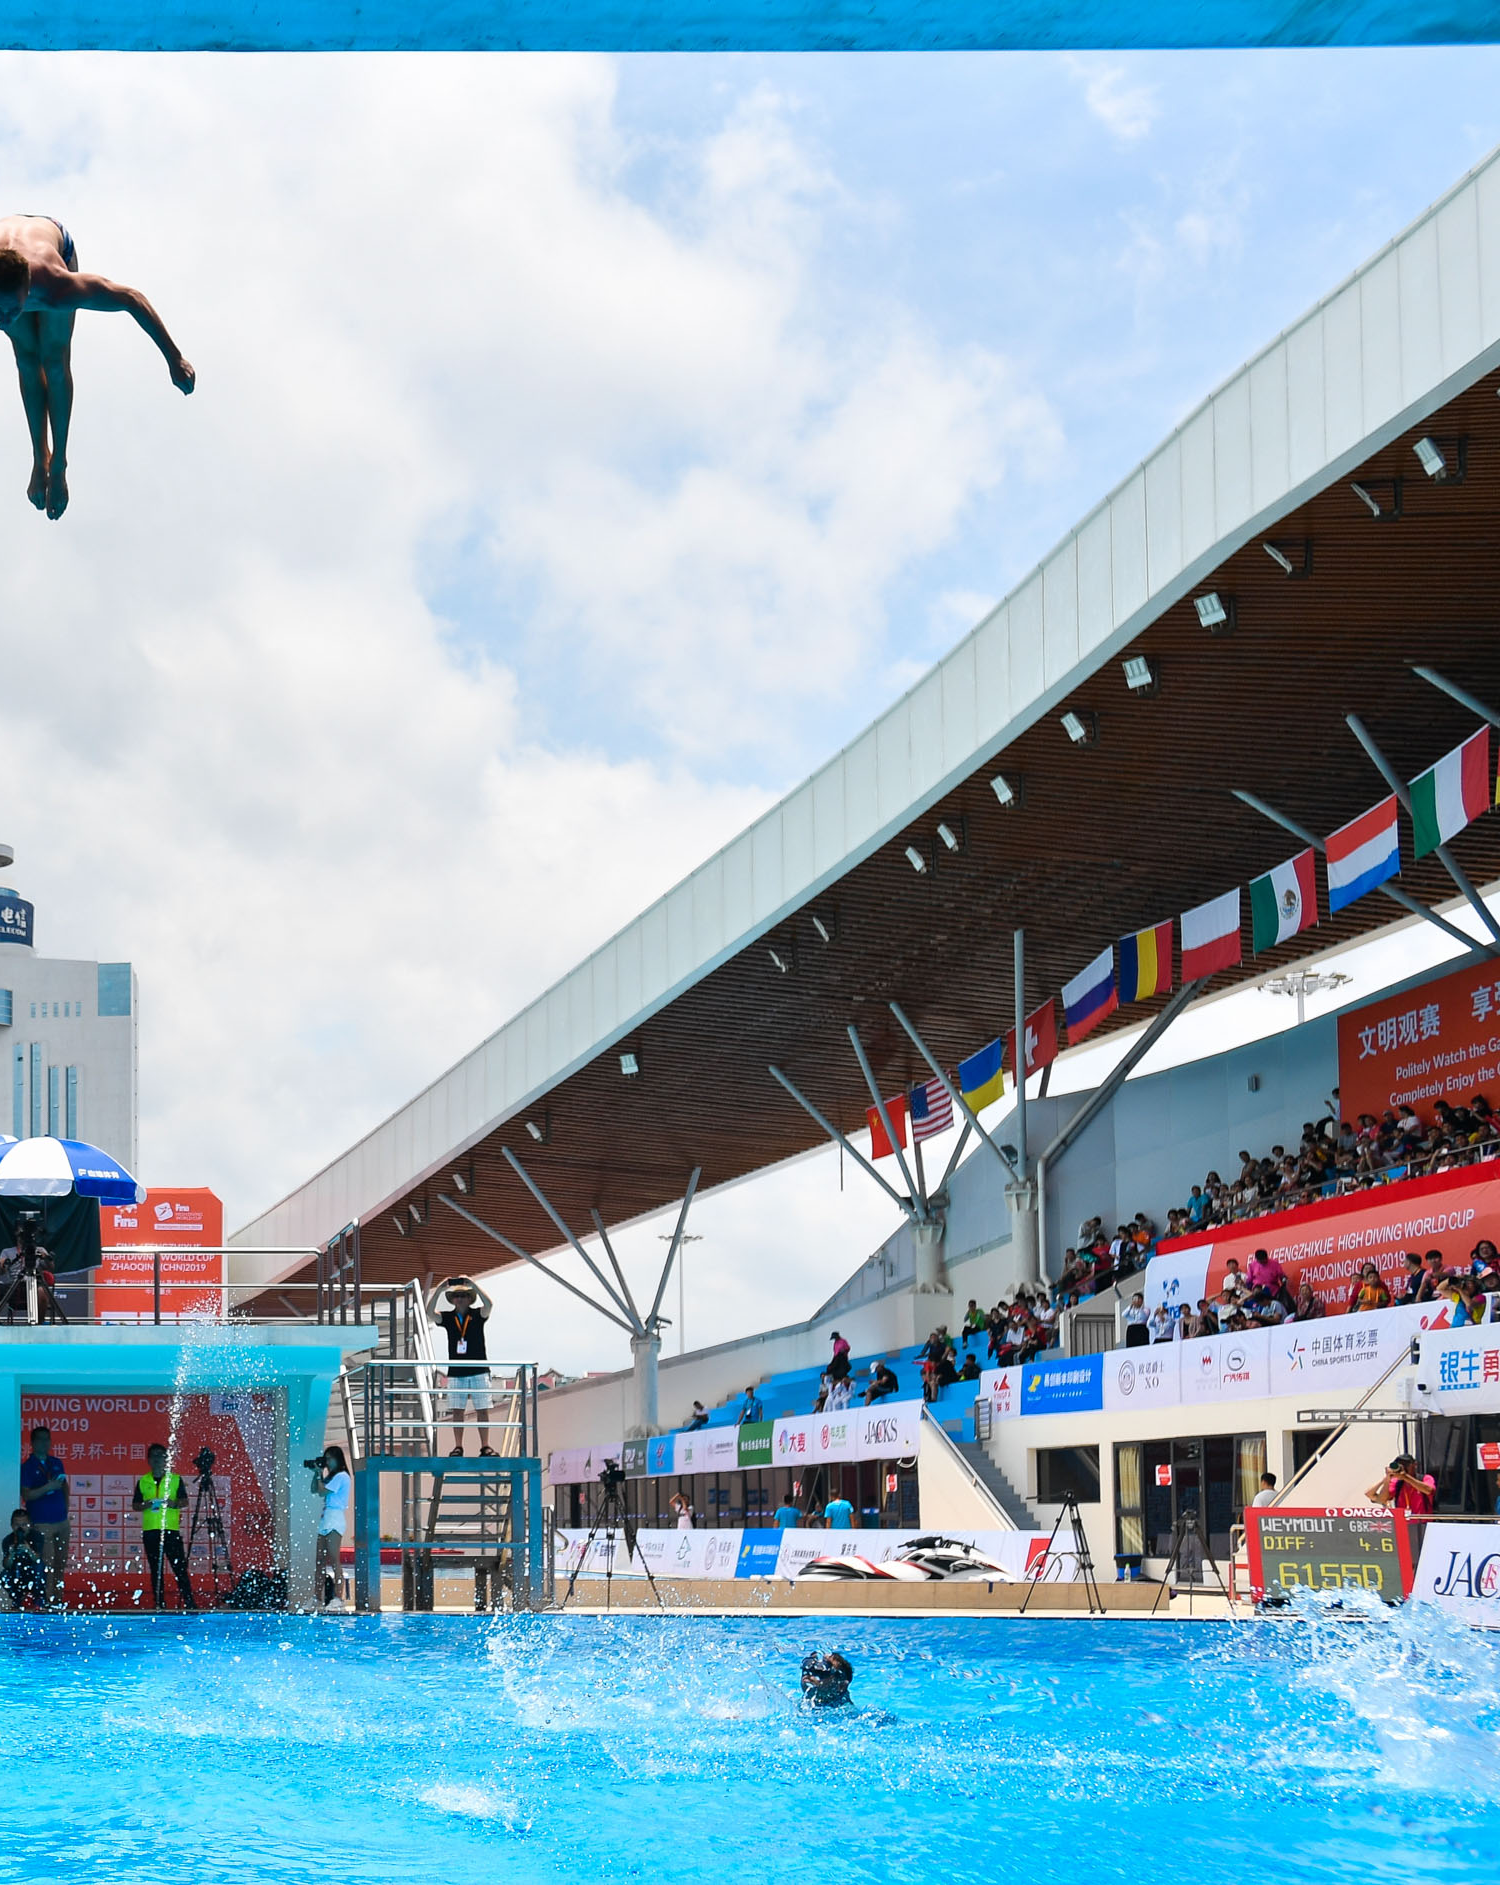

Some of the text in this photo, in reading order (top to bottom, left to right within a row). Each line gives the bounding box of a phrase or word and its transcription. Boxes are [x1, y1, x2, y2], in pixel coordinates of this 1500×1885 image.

[1358, 1004, 1440, 1060] 文明观赛
[1396, 1058, 1431, 1081] Politely
[1433, 1048, 1466, 1069] Watch
[1469, 1043, 1486, 1058] the
[1389, 1067, 1495, 1107] Completely Enjoy the
[1273, 1237, 1334, 1264] FENGZHIXUE
[1337, 1232, 1363, 1252] HIGH
[1365, 1225, 1402, 1247] DIVING
[1404, 1213, 1447, 1238] WORLD
[1448, 1208, 1474, 1230] CUP
[1311, 1328, 1378, 1356] 中国体育彩票
[1330, 1354, 1351, 1365] SPORTS
[1352, 1351, 1378, 1361] LOTTERY
[1440, 1350, 1480, 1383] 银牛
[22, 1398, 81, 1413] DIVING
[85, 1398, 150, 1413] WORLD
[789, 1432, 806, 1453] 大麦
[865, 1418, 898, 1445] JACKS
[1342, 1508, 1394, 1518] OMEGA
[1350, 1521, 1370, 1533] GBR
[1263, 1536, 1394, 1552] DIFF: 4.6
